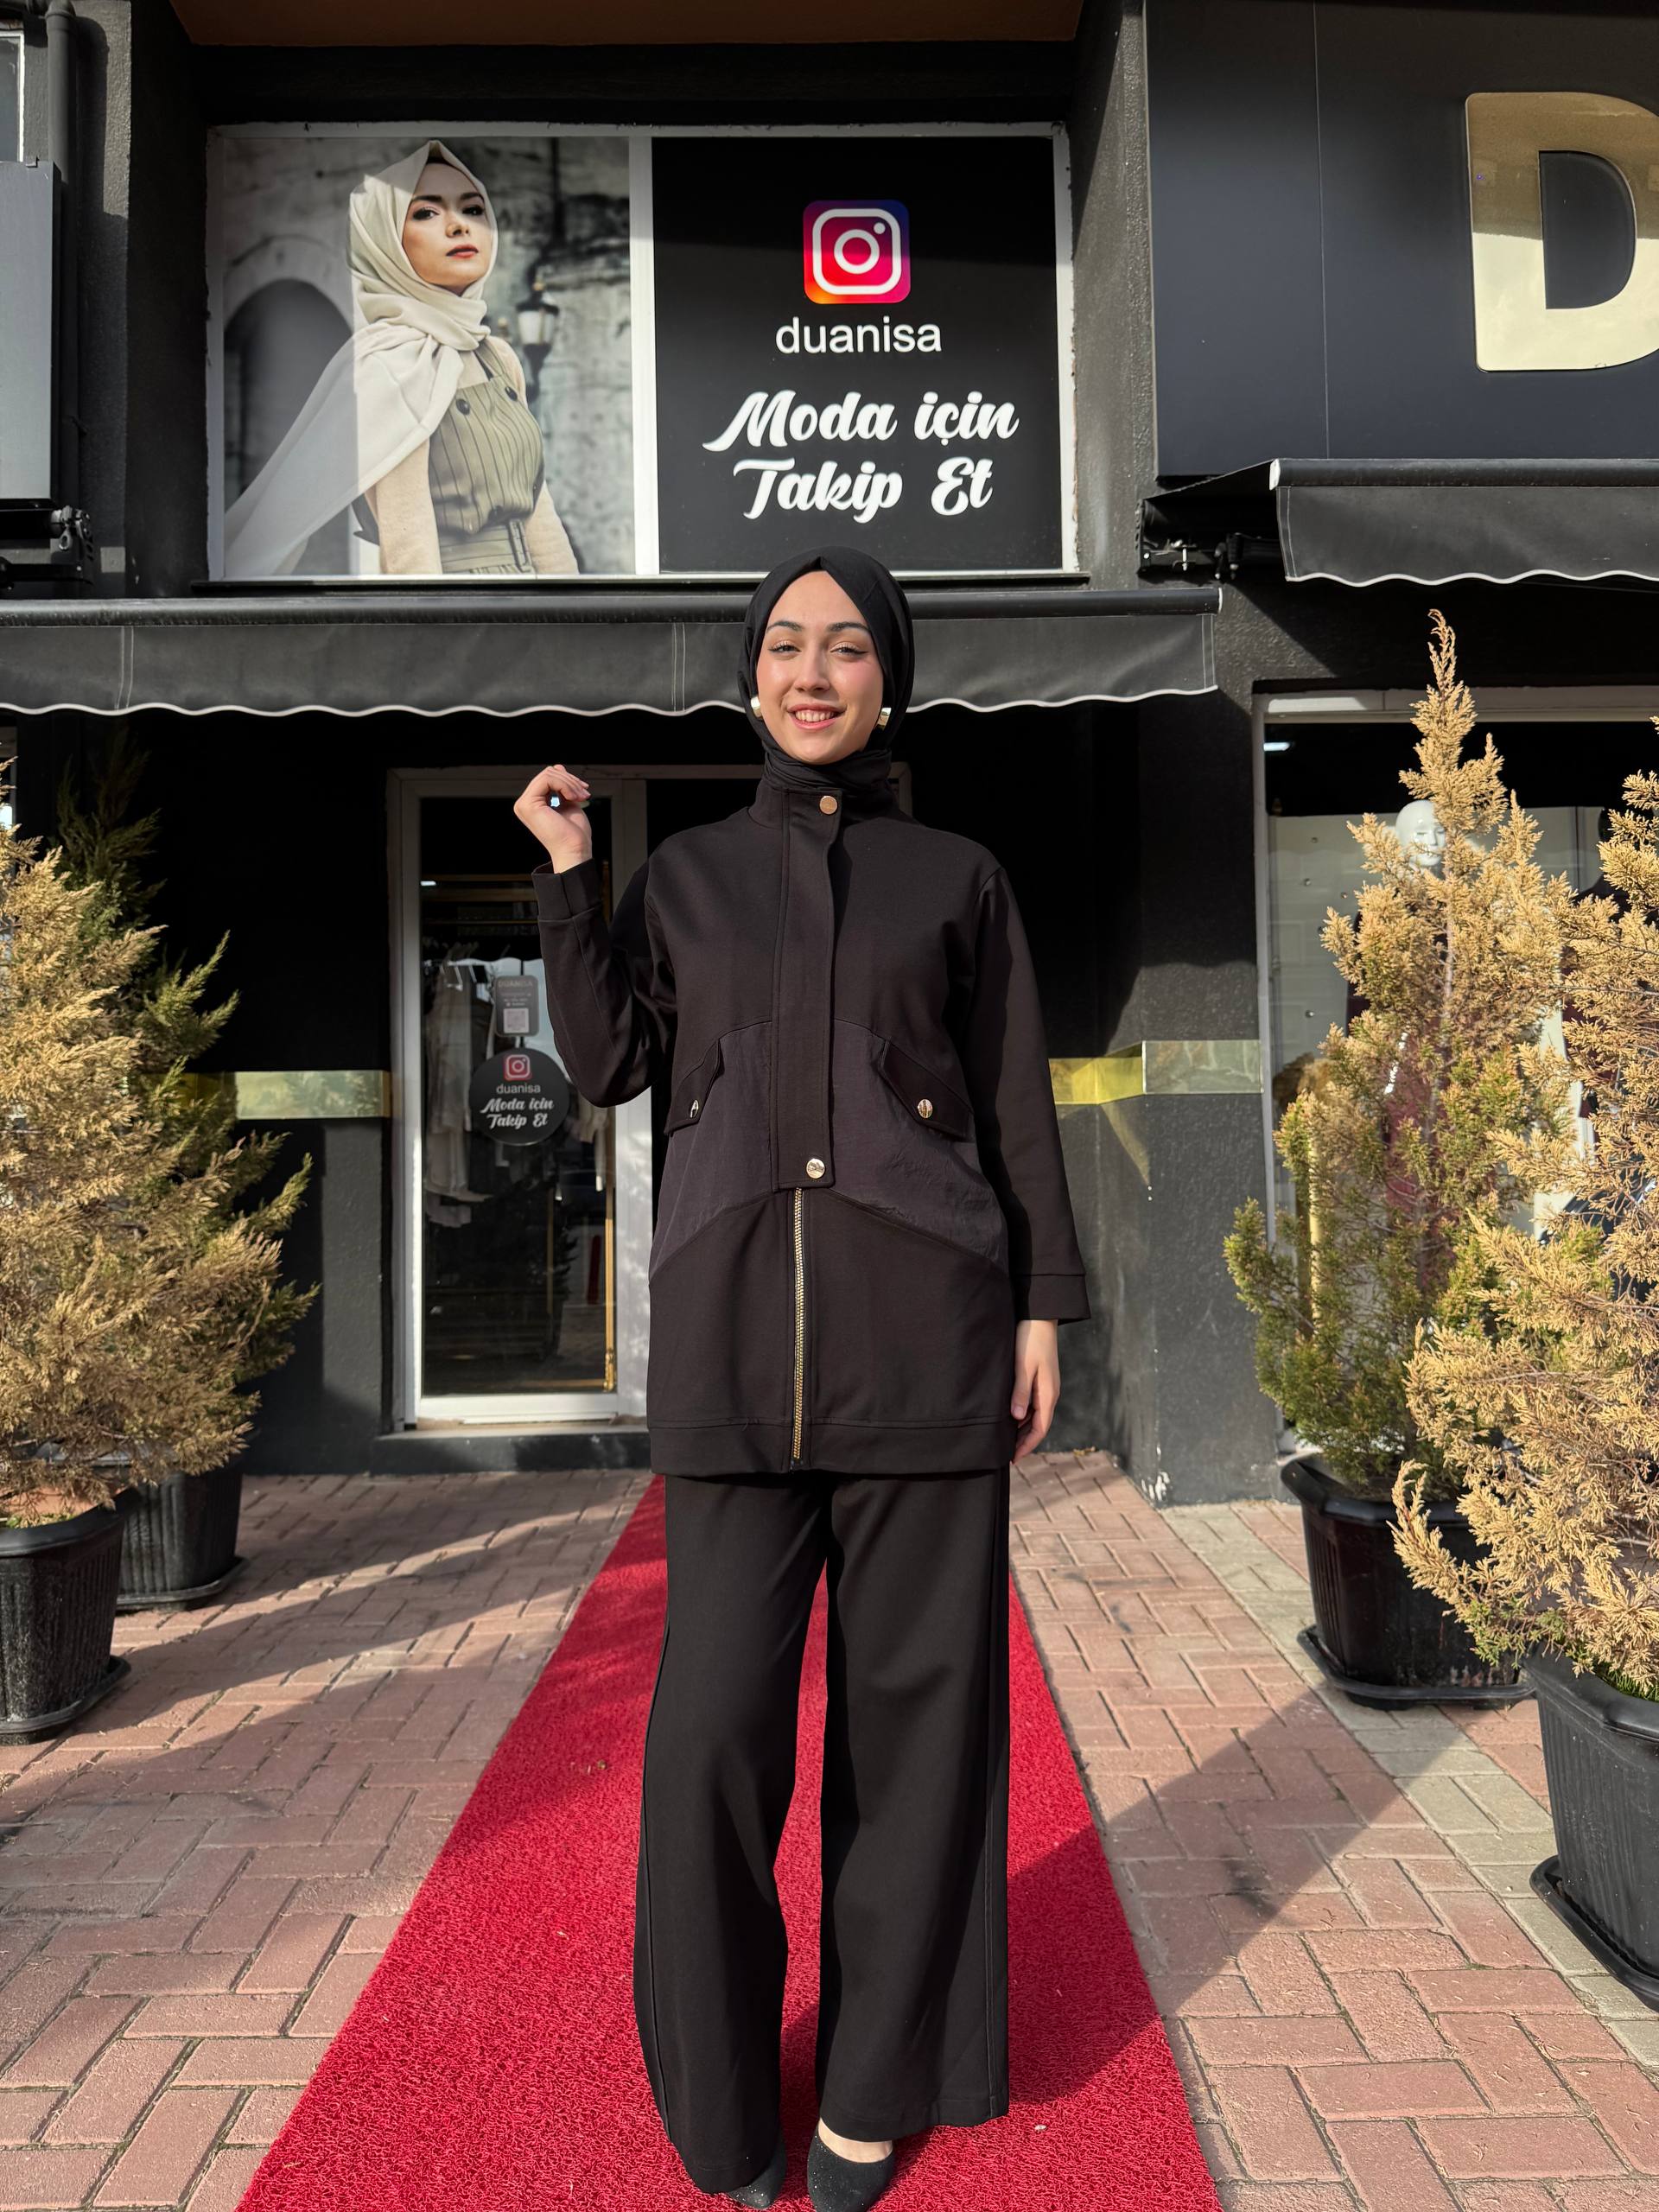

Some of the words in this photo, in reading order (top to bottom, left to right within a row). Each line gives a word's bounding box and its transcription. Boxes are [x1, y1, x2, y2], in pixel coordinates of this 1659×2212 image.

[1465, 92, 1659, 372] D
[776, 315, 942, 353] duanisa
[702, 390, 898, 452] Moda
[913, 391, 1020, 446] için
[733, 458, 903, 524] Takip
[931, 456, 994, 516] Et
[480, 1097, 525, 1113] Moda
[529, 1097, 554, 1111] için
[496, 1083, 541, 1094] duanisa
[487, 1114, 527, 1129] Takip
[532, 1113, 548, 1128] Et
